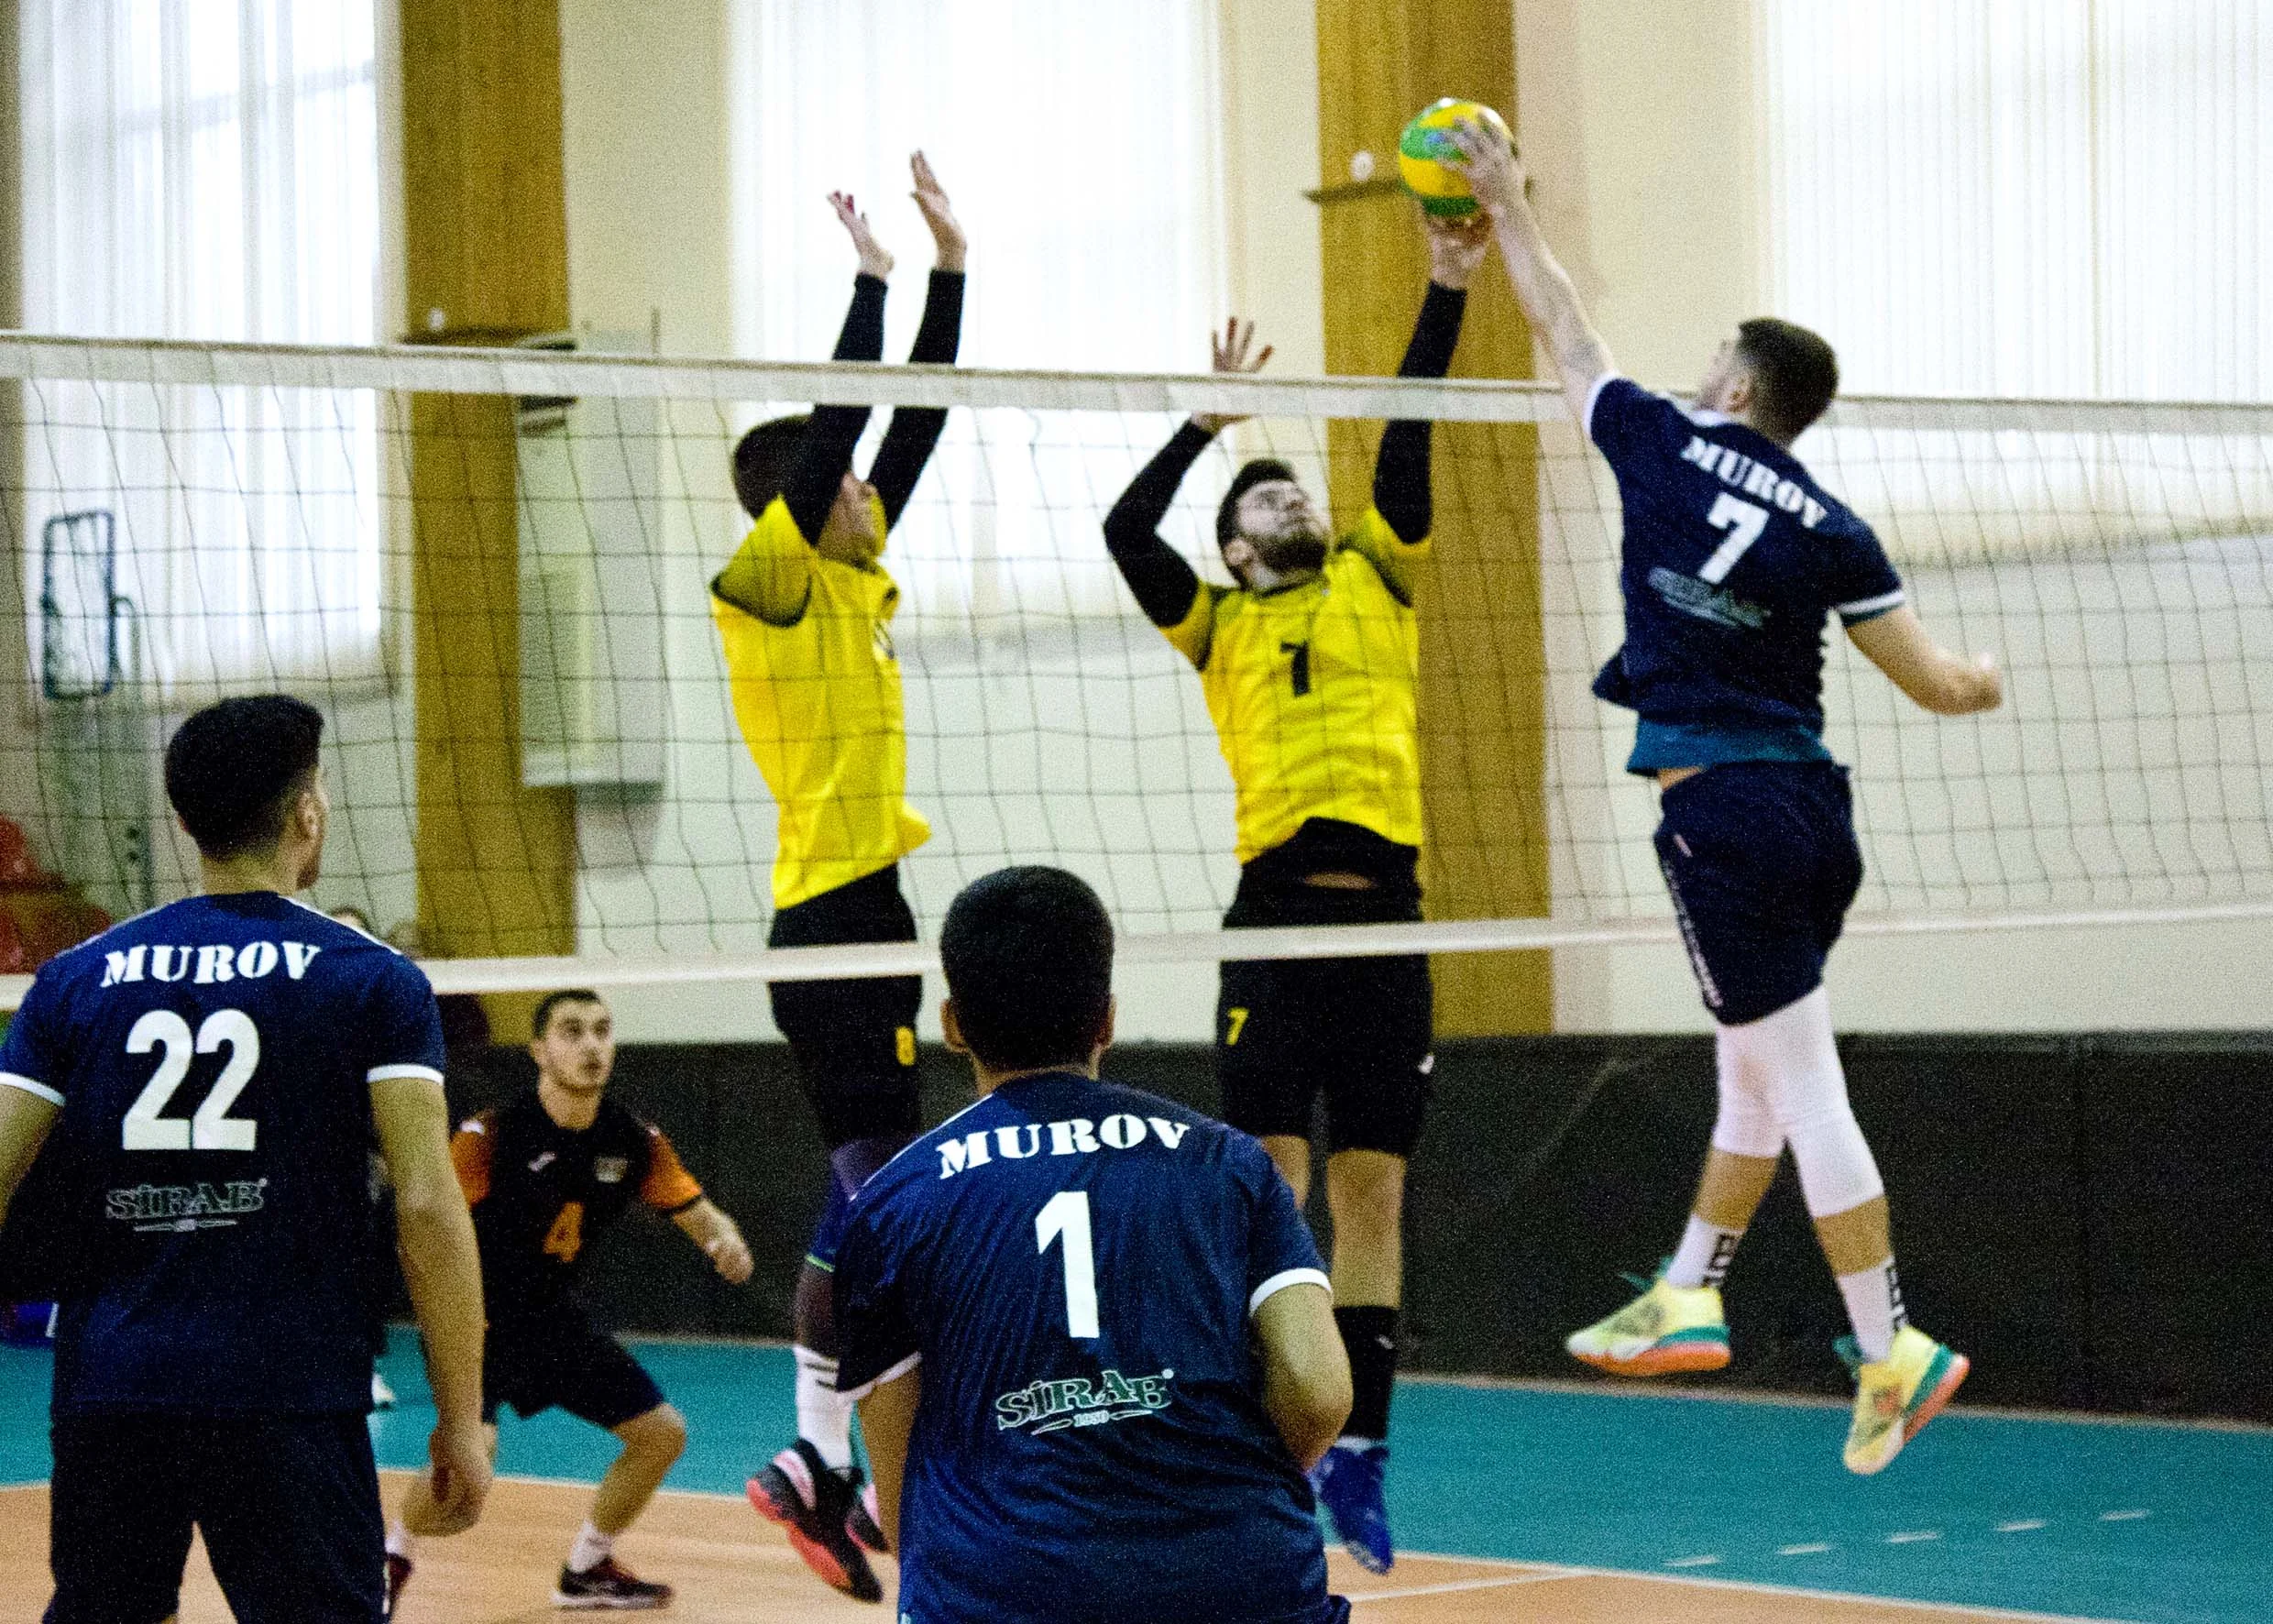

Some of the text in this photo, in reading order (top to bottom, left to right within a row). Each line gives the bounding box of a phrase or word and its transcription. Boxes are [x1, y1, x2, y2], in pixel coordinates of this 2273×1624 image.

[1680, 435, 1828, 529] MUROV
[1698, 492, 1770, 586] 7
[100, 941, 322, 987] MUROV
[1226, 1007, 1249, 1046] 7
[122, 1009, 261, 1151] 22
[937, 1114, 1191, 1180] MUROV
[544, 1202, 584, 1262] 4
[1035, 1191, 1100, 1339] 1
